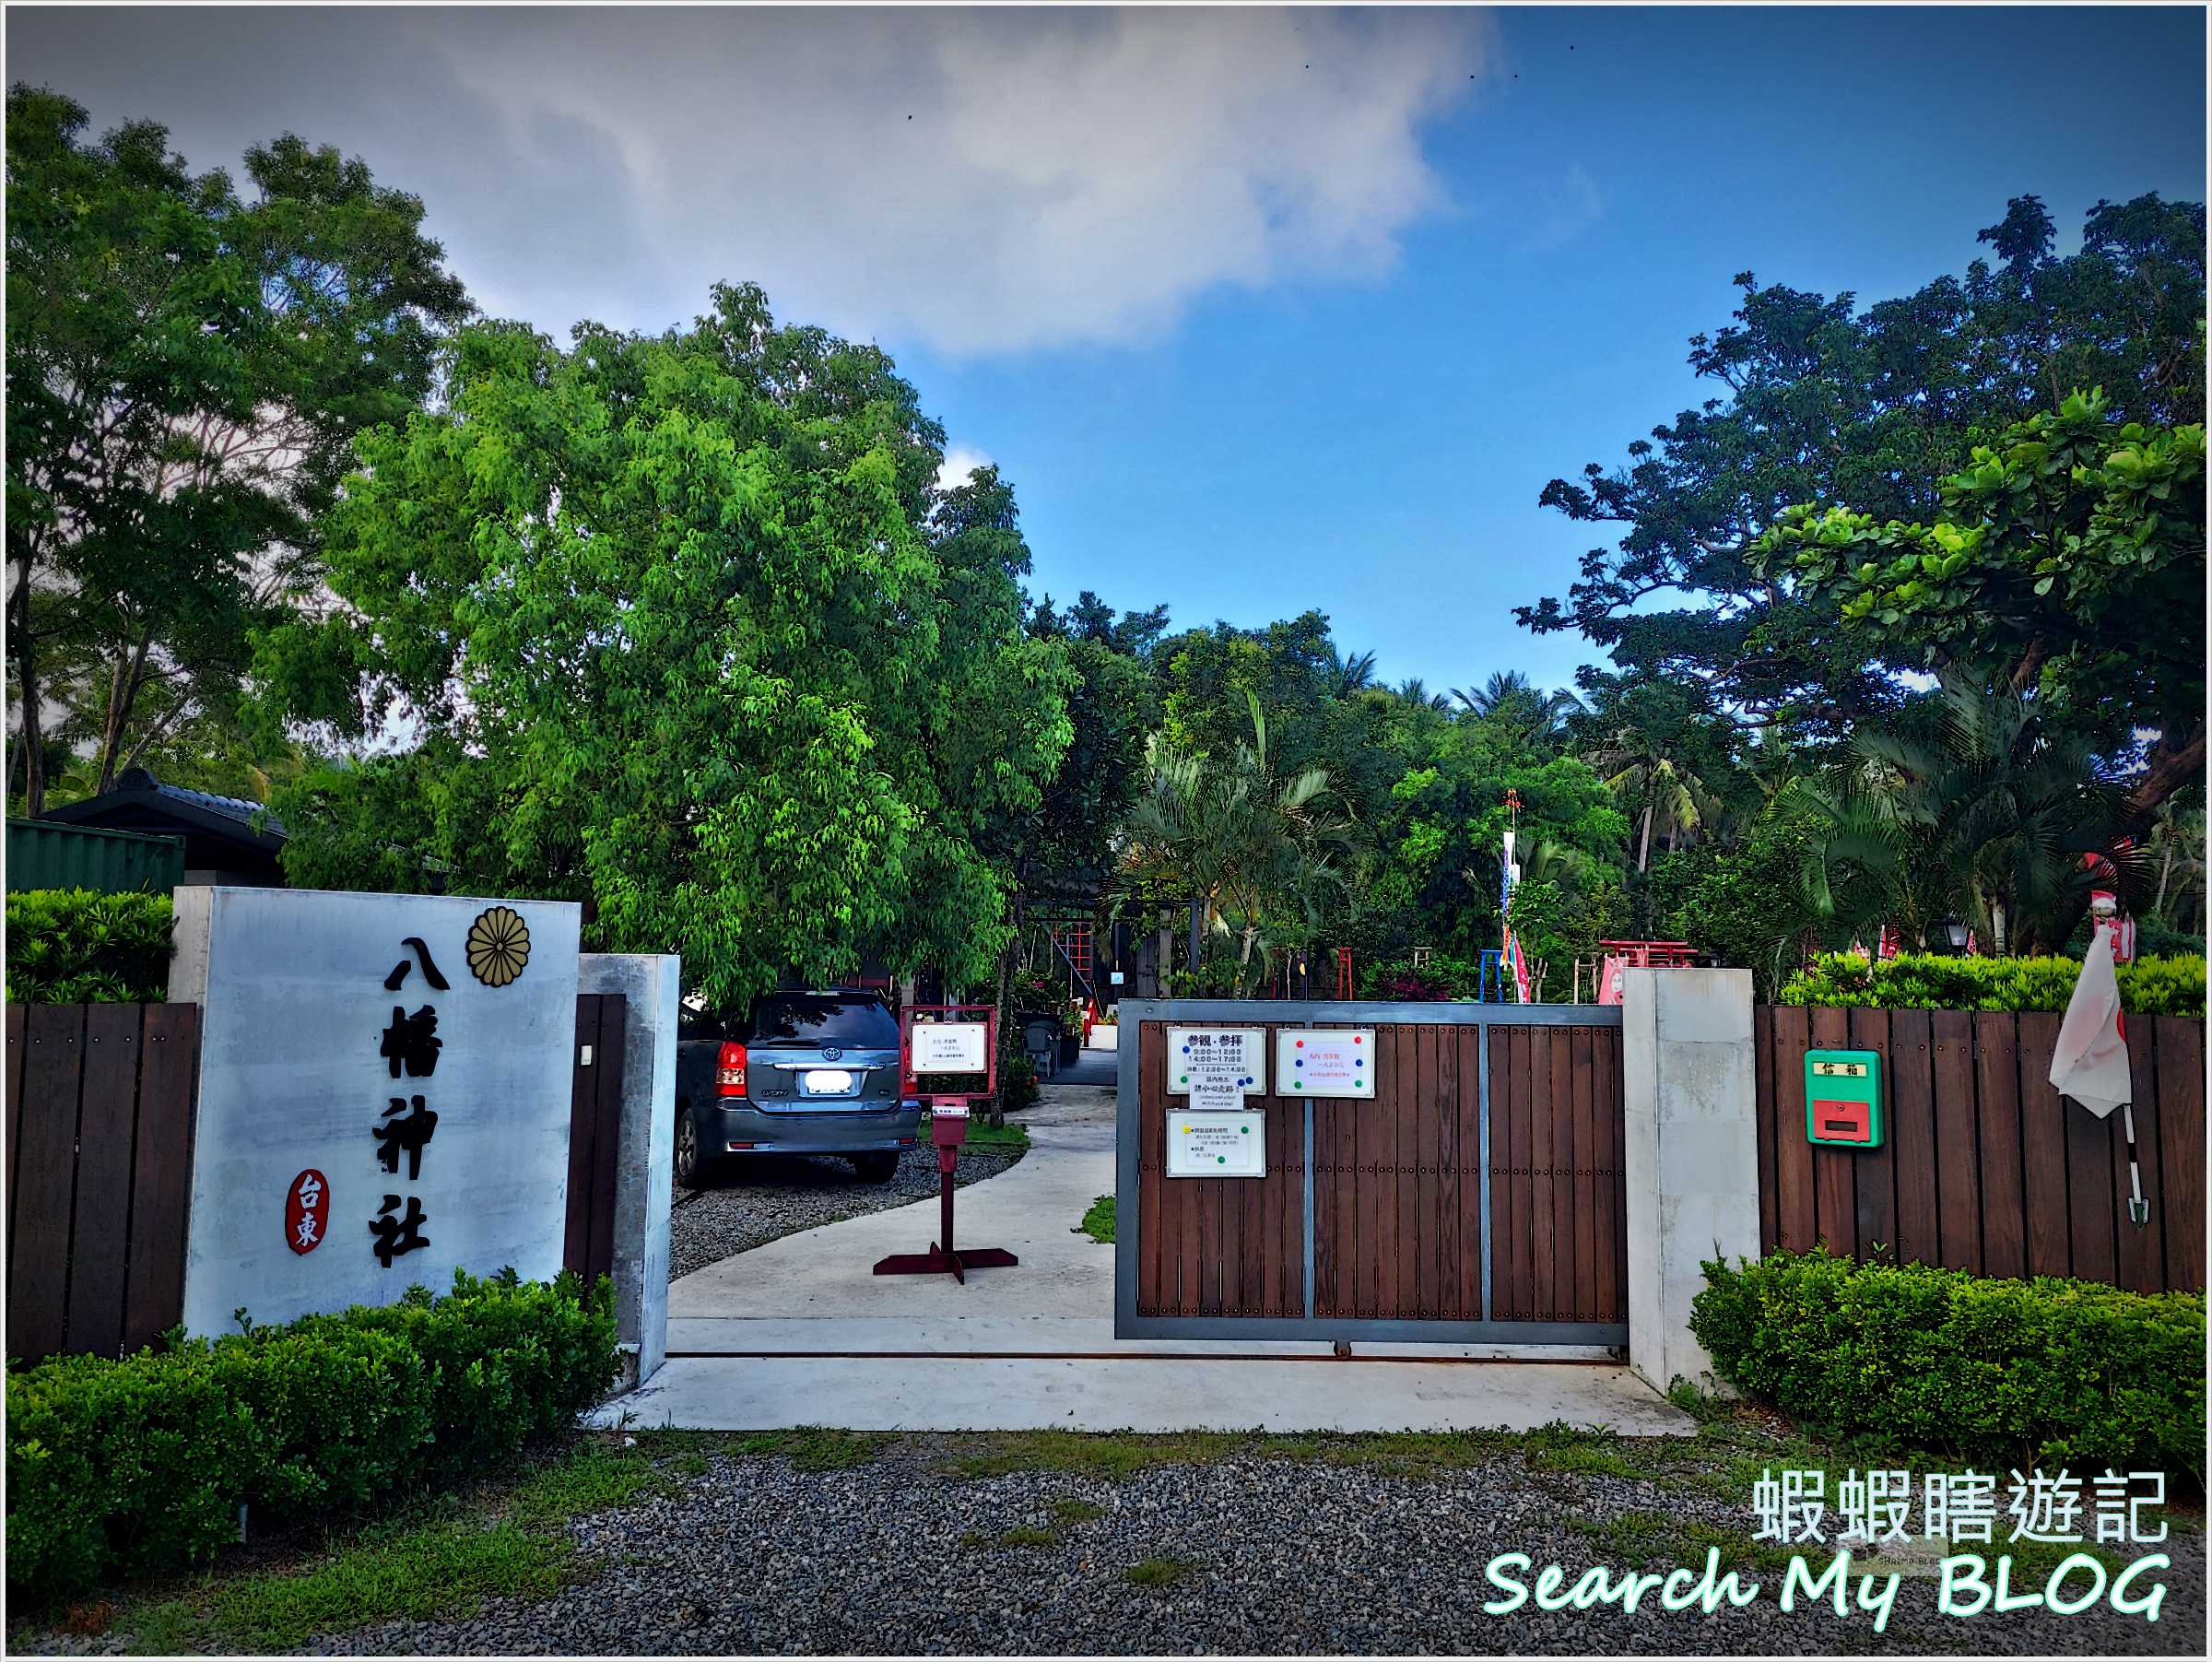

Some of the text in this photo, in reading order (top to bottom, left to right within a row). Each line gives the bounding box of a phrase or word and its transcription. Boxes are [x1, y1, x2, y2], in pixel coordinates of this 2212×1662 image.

[369, 937, 451, 1268] 八幡神社
[295, 1173, 323, 1247] 台東
